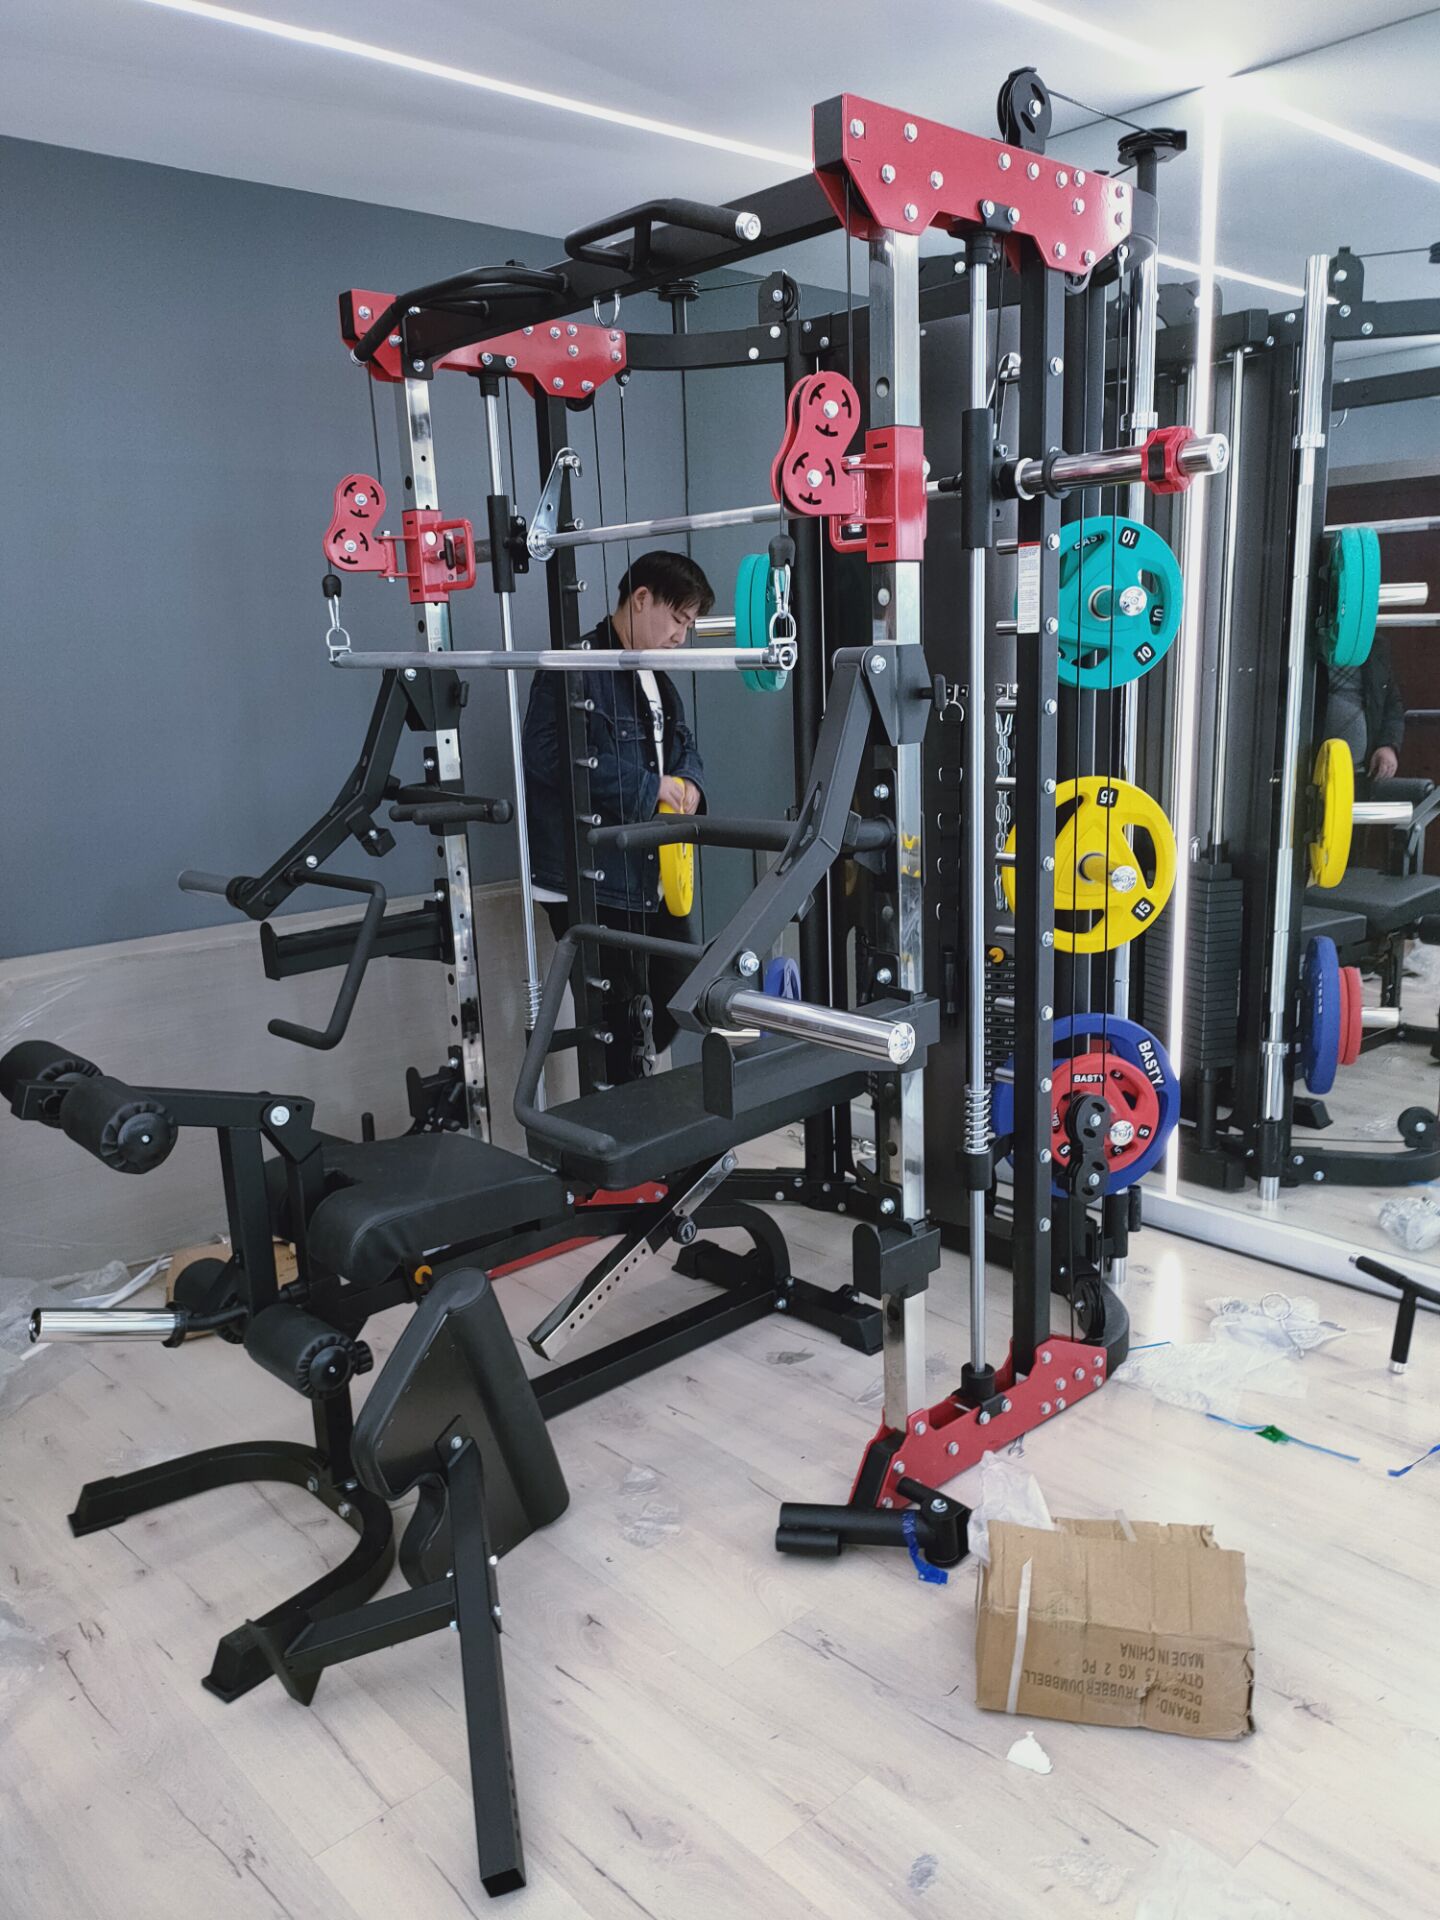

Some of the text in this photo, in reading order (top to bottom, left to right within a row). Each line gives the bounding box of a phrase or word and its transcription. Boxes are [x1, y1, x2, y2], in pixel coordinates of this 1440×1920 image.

[1121, 529, 1136, 545] 10
[1152, 608, 1164, 622] 10
[1137, 647, 1152, 662] 10
[1099, 790, 1114, 804] 15
[1135, 901, 1150, 918] 15
[1137, 1040, 1165, 1086] BASTY
[1073, 1074, 1105, 1083] BASTY
[1140, 1128, 1150, 1137] 5
[1119, 1643, 1204, 1669] MADE IN CHINA
[1104, 1662, 1112, 1676] 2
[1119, 1663, 1136, 1681] KG
[1023, 1669, 1084, 1695] DUMBBELL
[1155, 1697, 1200, 1724] BRAND:
